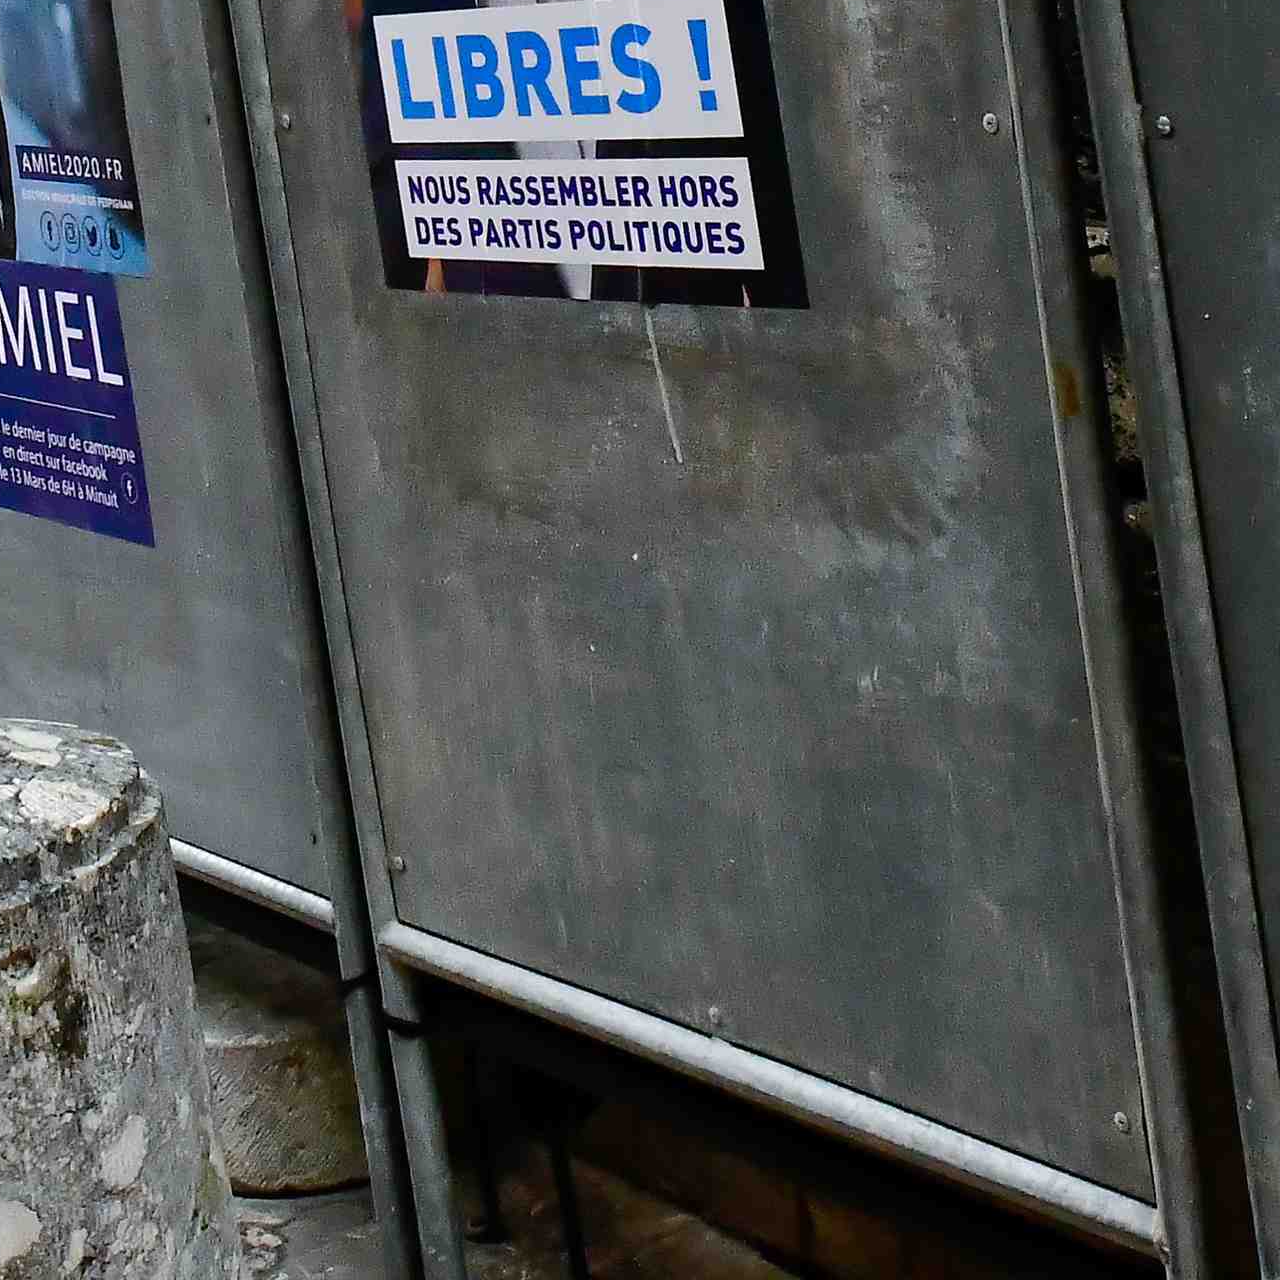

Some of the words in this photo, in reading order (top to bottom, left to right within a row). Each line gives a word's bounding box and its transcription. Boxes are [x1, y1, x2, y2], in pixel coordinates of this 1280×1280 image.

[391, 23, 662, 120] LIBRES
[687, 19, 718, 112] !
[22, 152, 124, 181] AMIEL2020.FR
[407, 175, 471, 206] NOUS
[477, 175, 652, 208] RASSEMBLER
[657, 175, 739, 208] HORS
[414, 217, 462, 247] DES
[468, 218, 562, 250] PARTIS
[569, 221, 745, 255] POLITIQUES
[1, 417, 12, 436] le
[12, 421, 46, 443] dernier
[47, 427, 67, 449] jour
[69, 432, 82, 451] de
[83, 439, 137, 465] campagne
[2, 445, 16, 460] en
[17, 445, 45, 467] direct
[46, 455, 62, 471] sur
[61, 454, 109, 482] facebook
[0, 463, 9, 482] le
[10, 466, 22, 485] 13
[23, 469, 47, 491] Mars
[48, 475, 61, 494] de
[62, 479, 76, 497] 6H
[77, 482, 85, 500] à
[84, 484, 120, 510] Minuit
